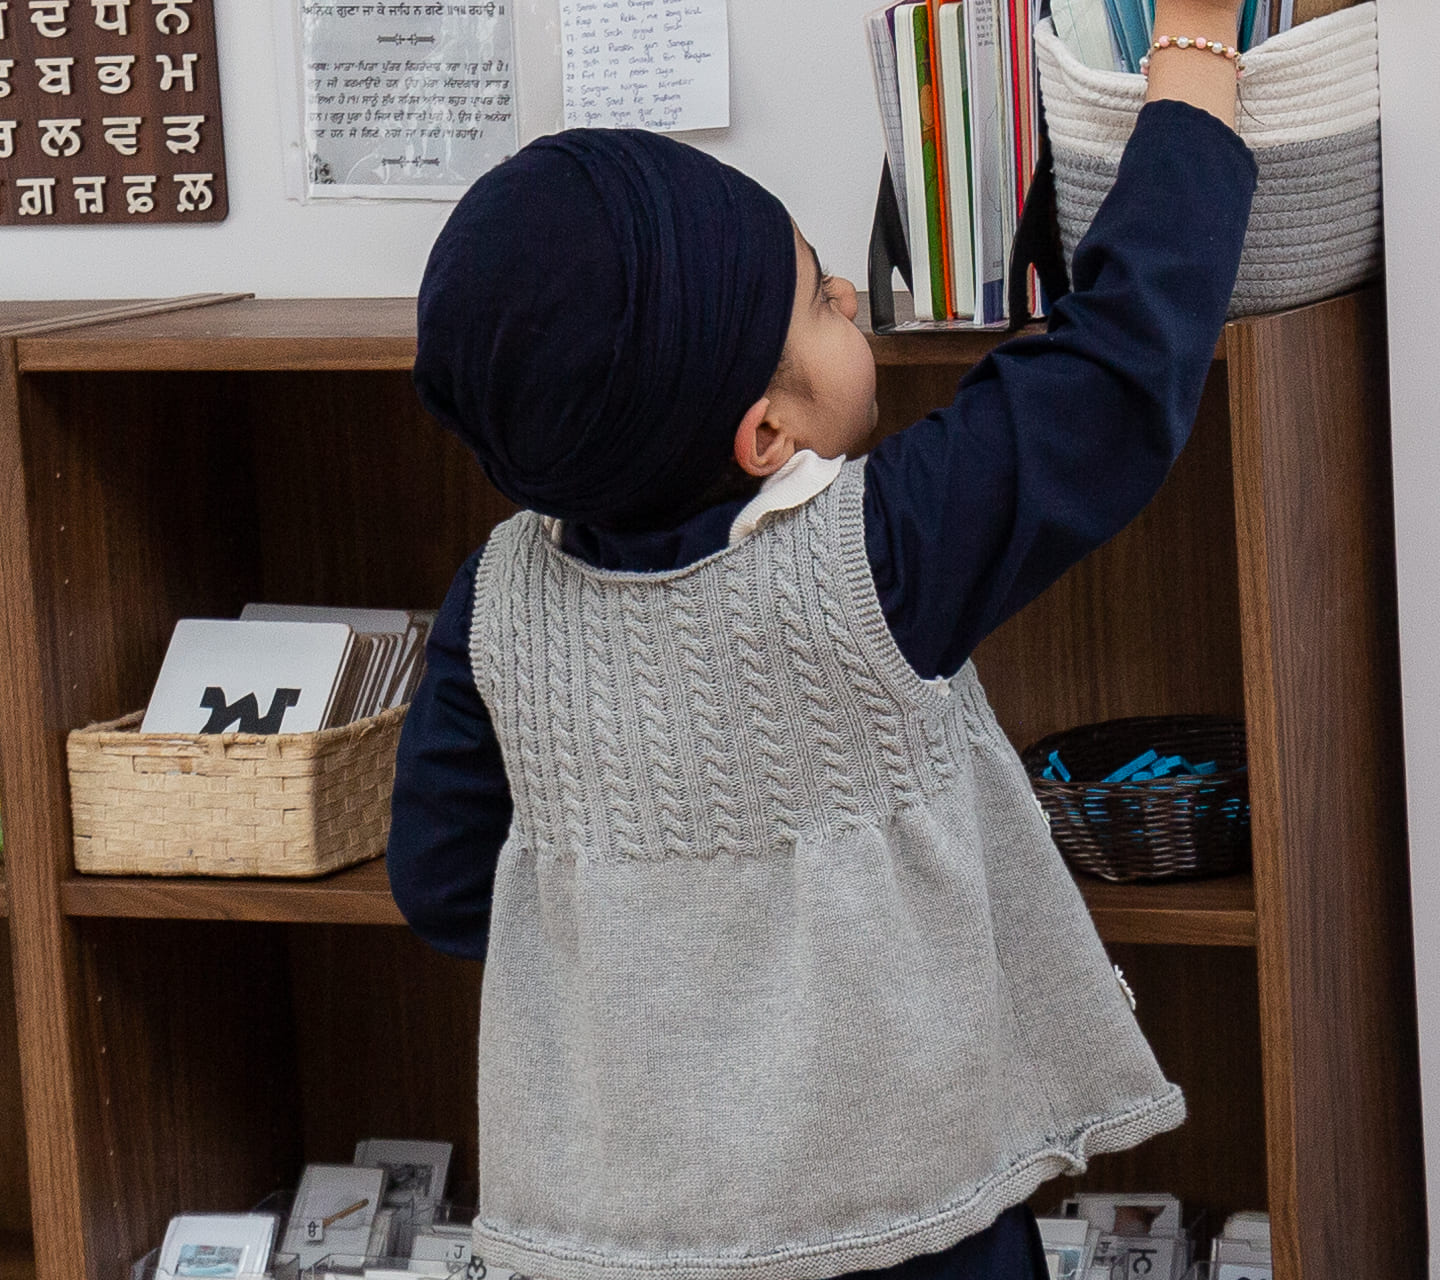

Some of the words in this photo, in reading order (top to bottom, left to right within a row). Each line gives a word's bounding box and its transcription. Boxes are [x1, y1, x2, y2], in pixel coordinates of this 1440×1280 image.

[28, 0, 69, 38] ਦ
[34, 57, 74, 95] ਬ
[94, 55, 135, 94] ਭ
[155, 53, 197, 92] ਮ
[38, 118, 81, 157] ਲ
[102, 116, 142, 156] ਵ
[163, 115, 205, 154] ੜ
